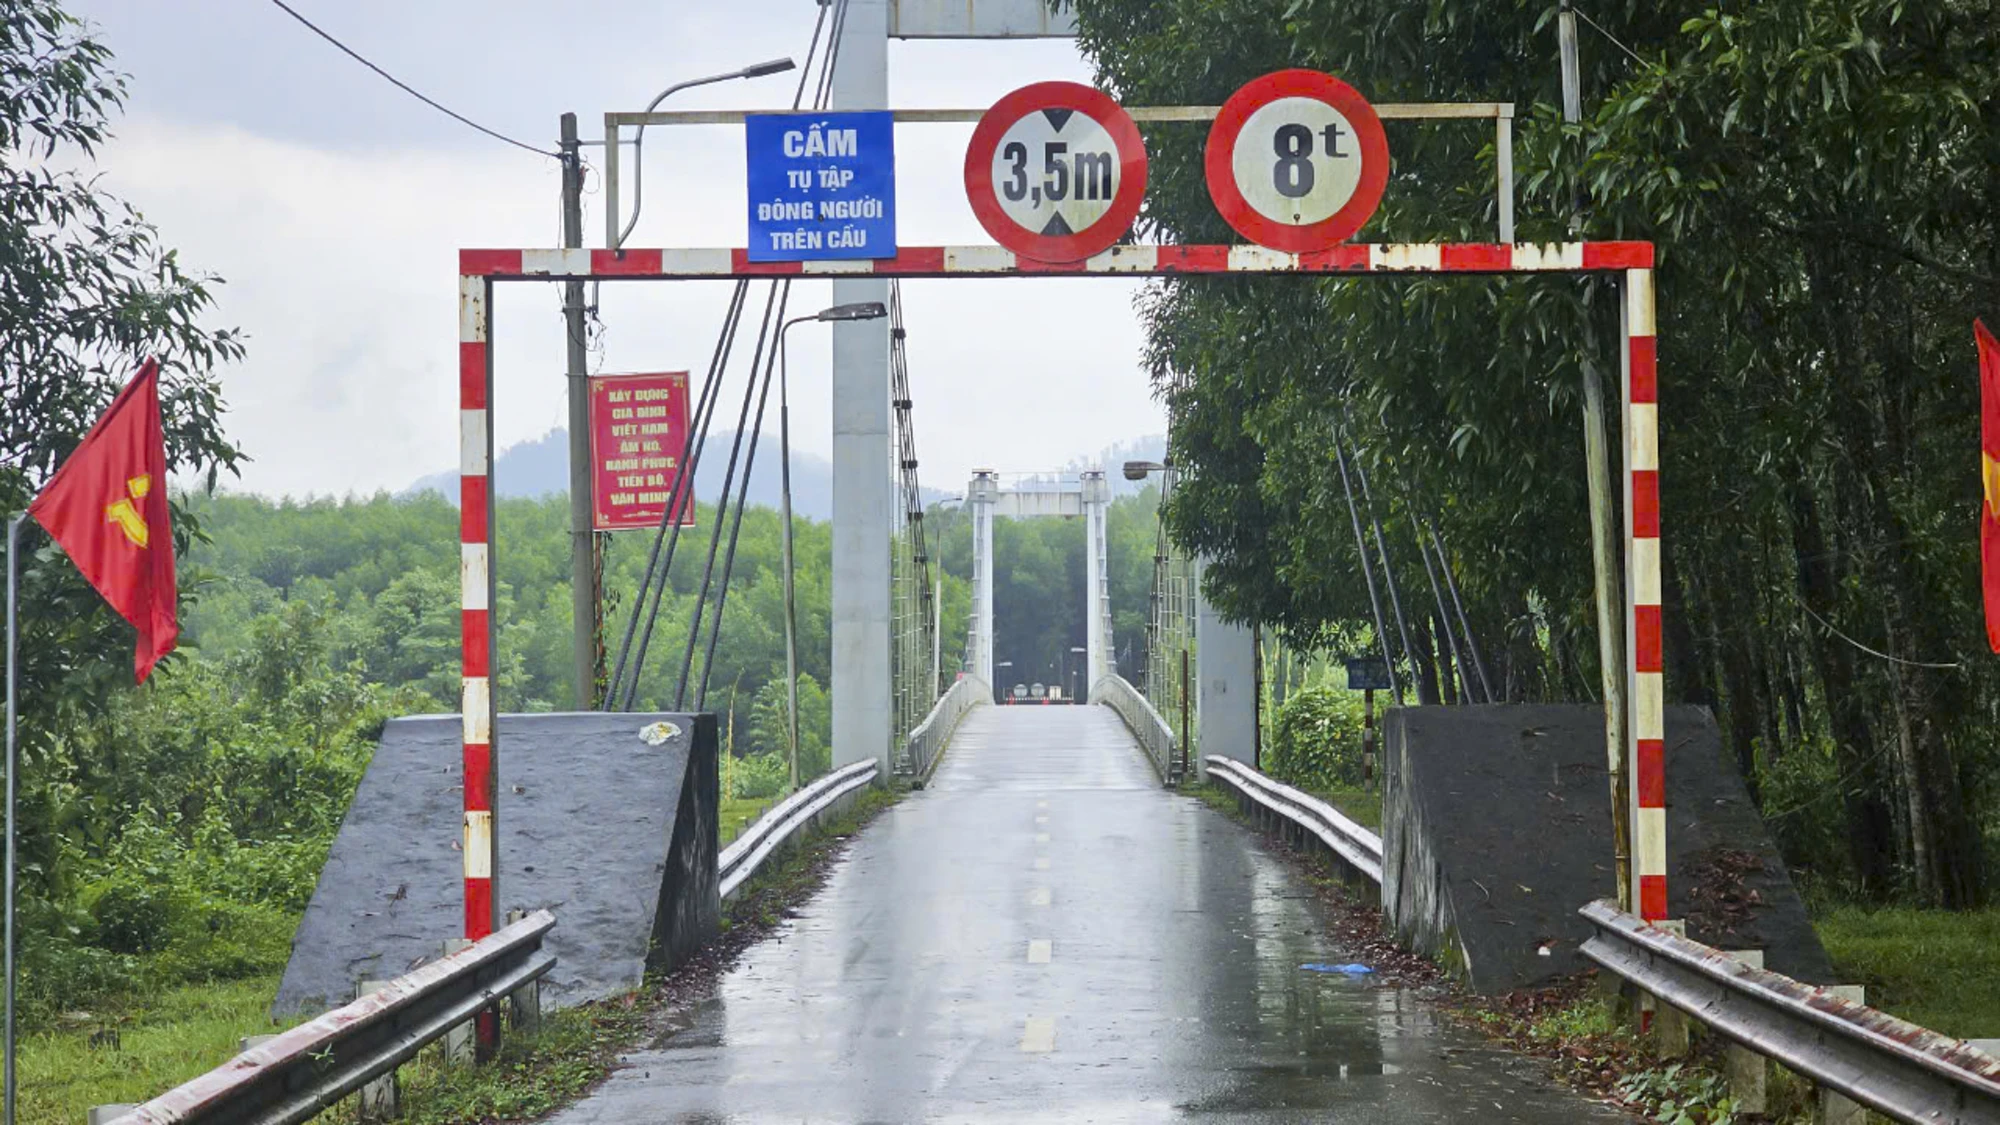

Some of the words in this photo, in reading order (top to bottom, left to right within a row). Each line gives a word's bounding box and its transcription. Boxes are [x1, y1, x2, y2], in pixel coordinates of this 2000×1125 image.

[783, 121, 857, 158] CẤM
[1273, 123, 1348, 199] 8t
[787, 170, 812, 193] TỤ
[817, 165, 854, 192] TẬP
[1002, 141, 1112, 210] 3,5m
[757, 198, 814, 222] ĐÔNG
[819, 195, 883, 220] NGƯỜI
[770, 228, 822, 251] TRÊN
[613, 407, 632, 419] GIA
[612, 424, 637, 436] VIỆT
[642, 424, 667, 433] NAM
